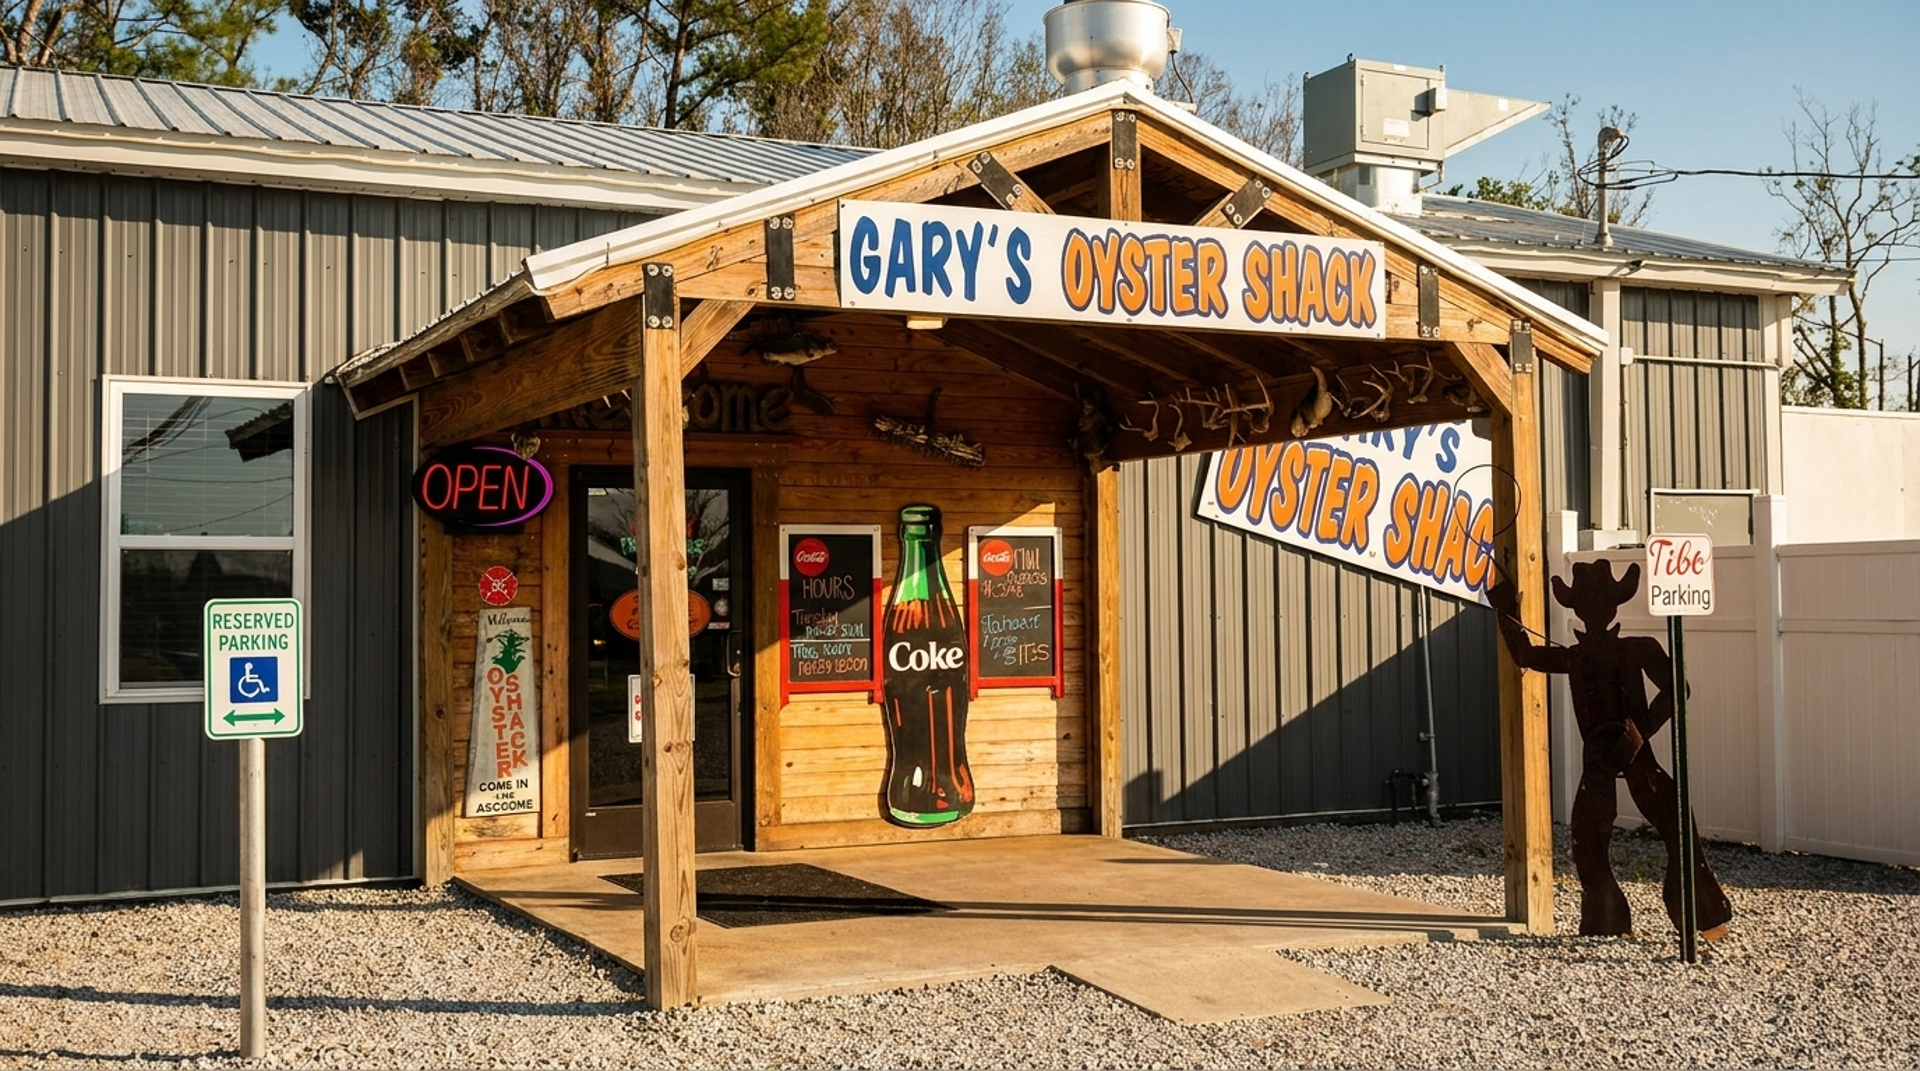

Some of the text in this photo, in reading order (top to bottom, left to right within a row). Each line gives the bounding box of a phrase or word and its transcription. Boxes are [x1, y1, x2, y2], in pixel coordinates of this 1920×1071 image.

[850, 215, 1377, 329] GARY'S OYSTER SHACK
[422, 463, 530, 510] OPEN
[1215, 441, 1495, 591] OYSTER SHAC
[803, 575, 855, 600] HOURS
[1652, 584, 1711, 610] Parking
[213, 613, 294, 629] RESERVED
[219, 634, 289, 651] PARKING
[889, 641, 964, 672] Coke
[487, 667, 513, 779] OYSTER
[505, 674, 529, 769] SHACK
[479, 778, 529, 793] COME IN
